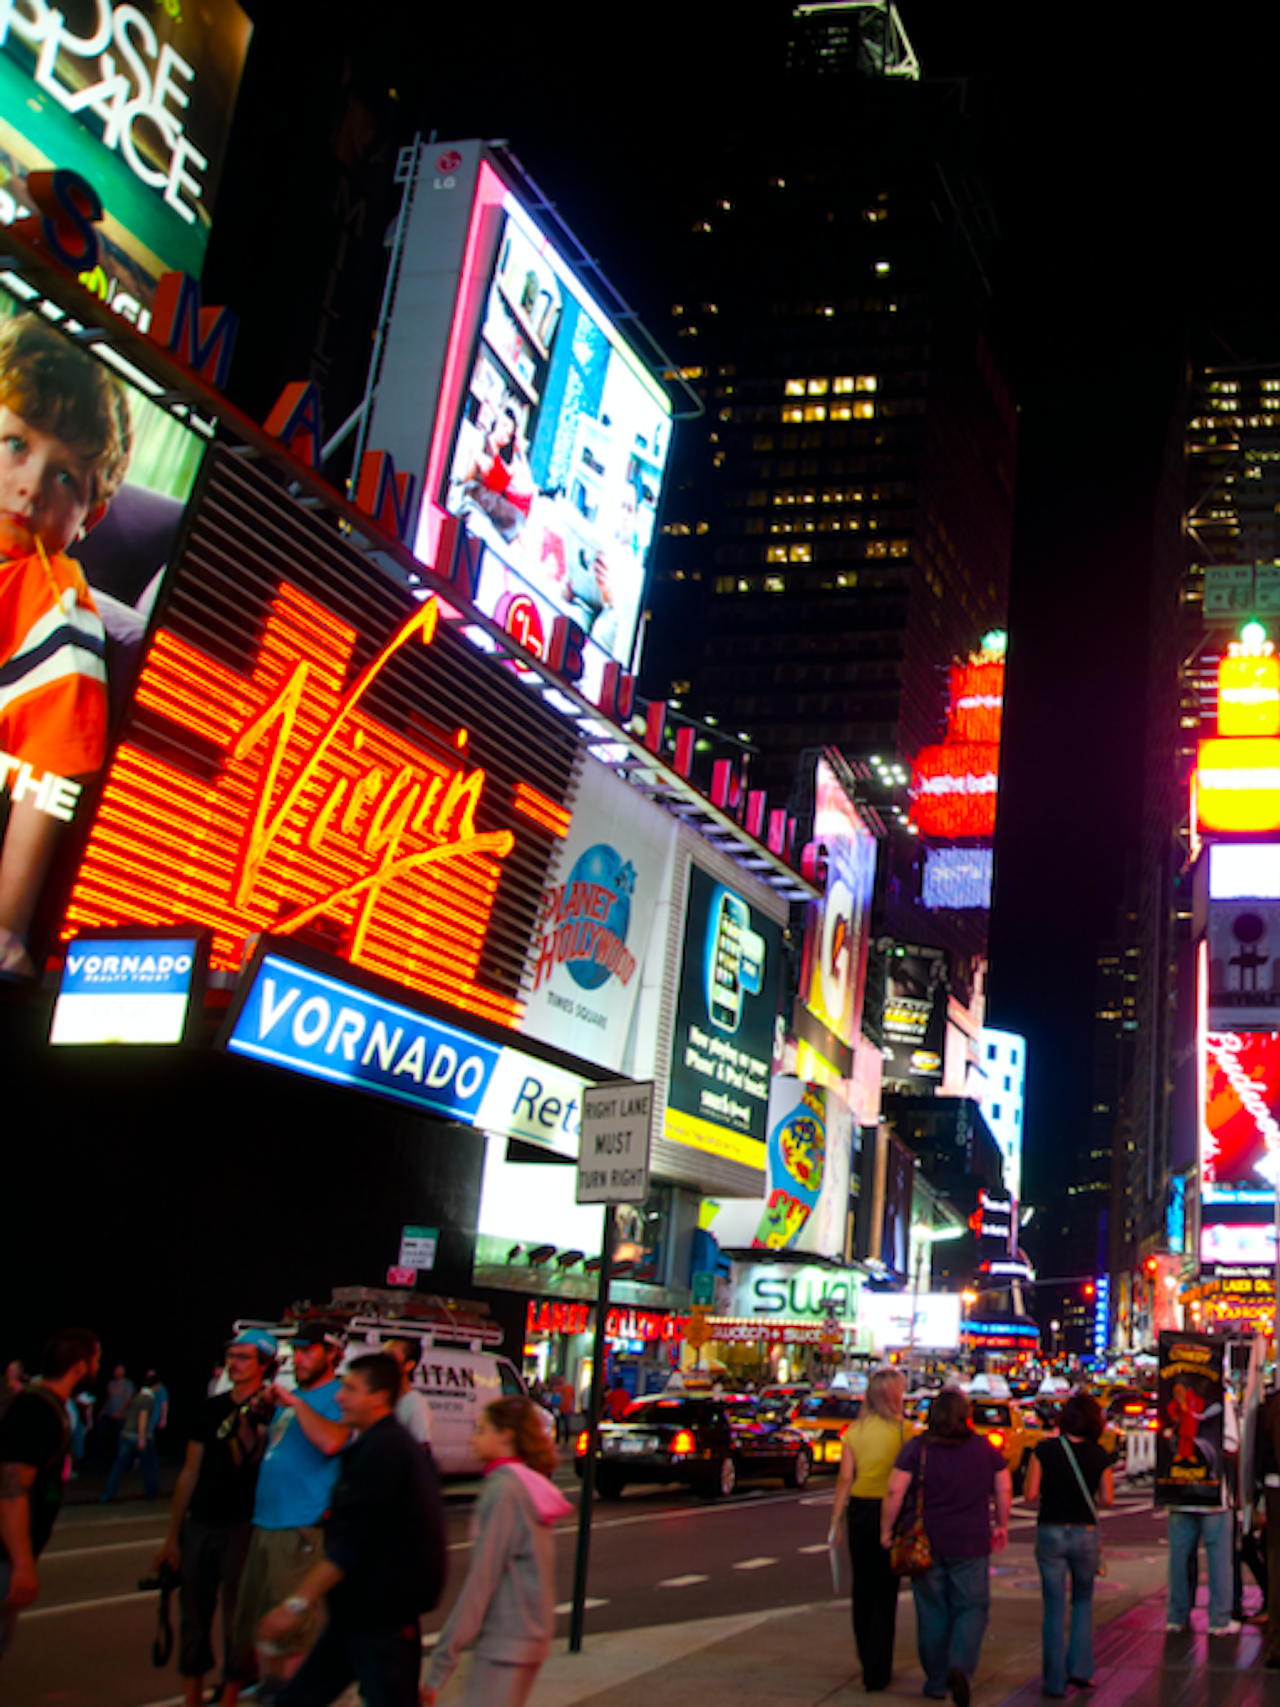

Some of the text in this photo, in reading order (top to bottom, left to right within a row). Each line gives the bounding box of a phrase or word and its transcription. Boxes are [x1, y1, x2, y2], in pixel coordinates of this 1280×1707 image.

[433, 176, 456, 190] LG
[0, 752, 82, 823] THE
[232, 594, 515, 962] Virgin
[541, 879, 619, 925] PLANET
[66, 954, 193, 976] VORNADO
[531, 919, 637, 993] HOLLYWOOD
[258, 977, 485, 1100] VORNADO
[586, 1096, 648, 1119] RIGHT LANE
[595, 1130, 632, 1155] MUST
[580, 1167, 644, 1189] TURN RIGHT
[526, 1299, 691, 1342] LANET OLLYWOO
[421, 1363, 475, 1389] ITAN
